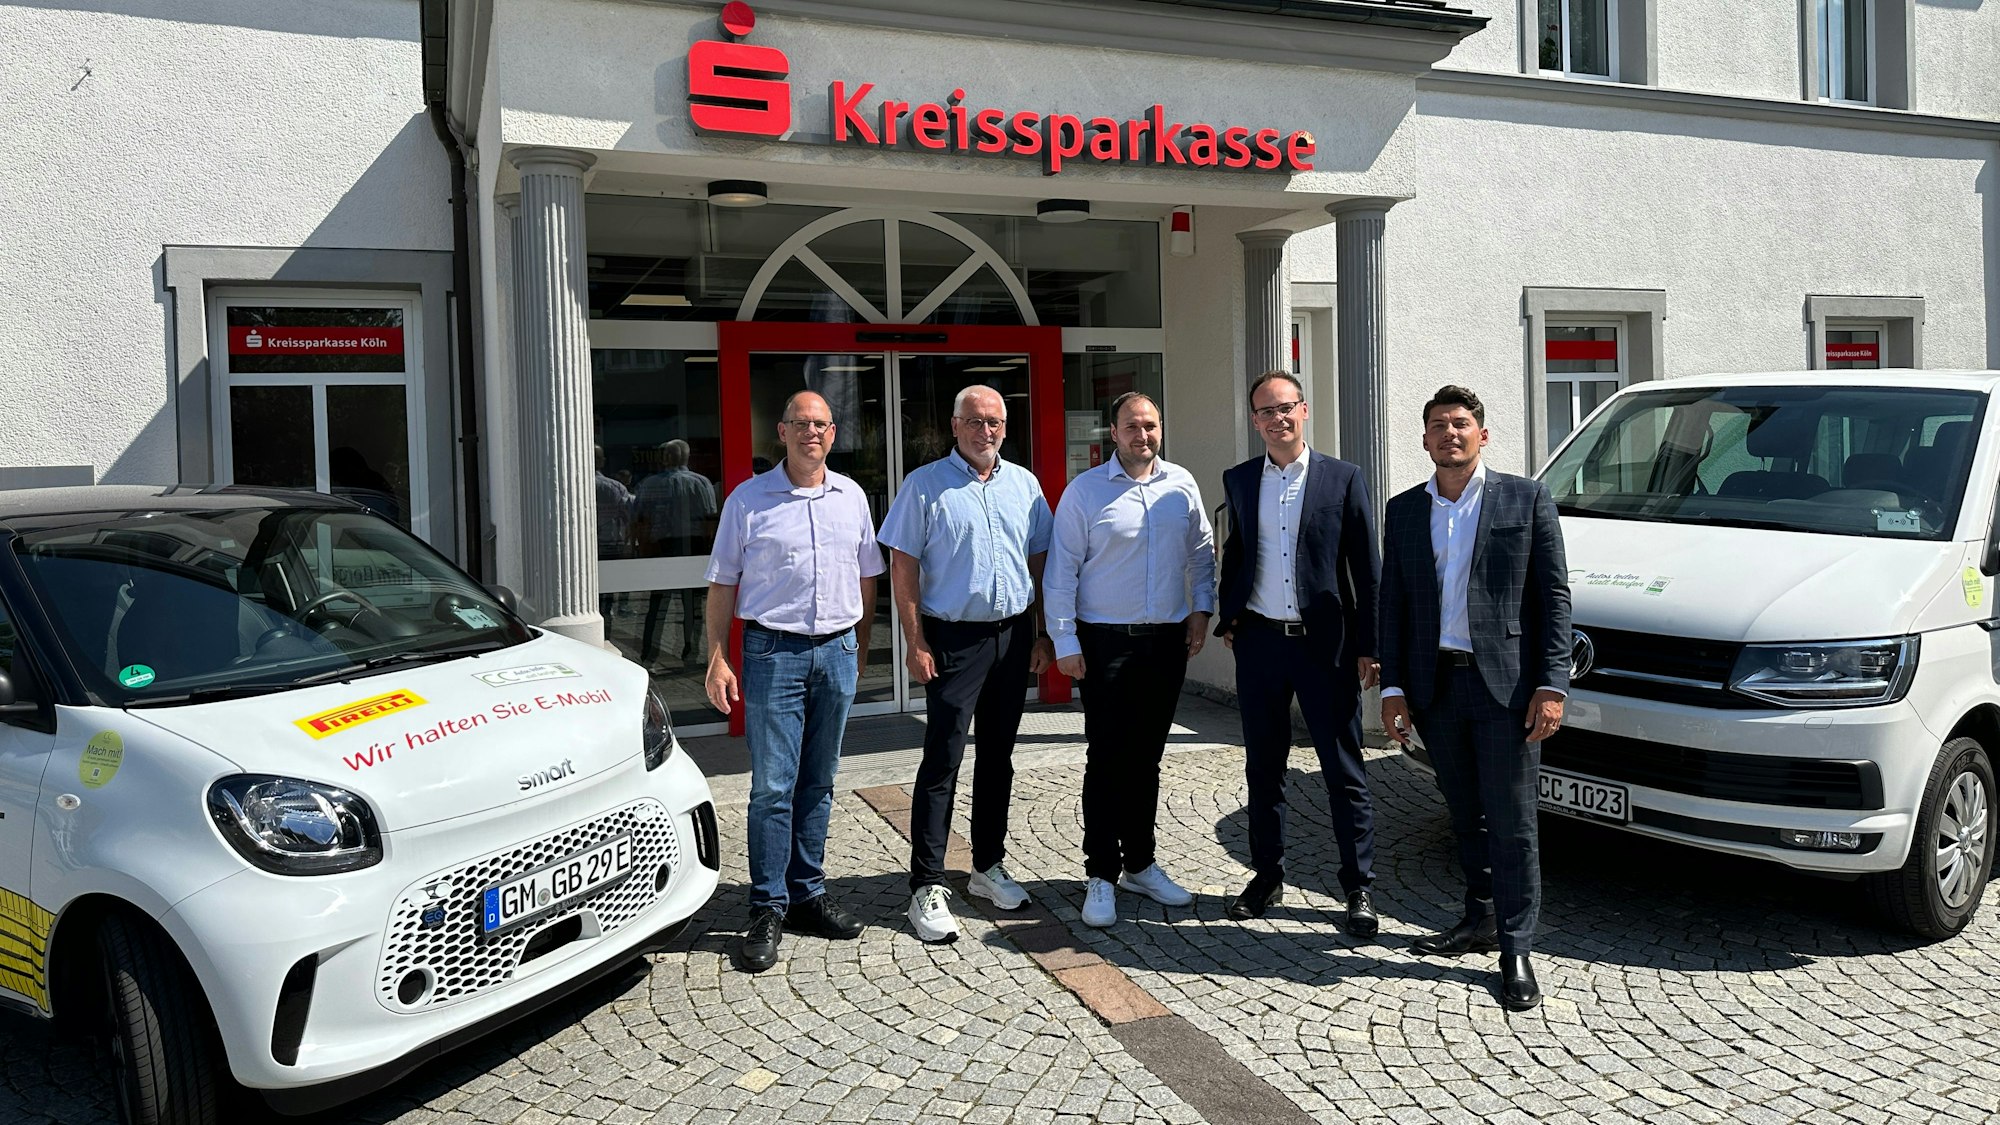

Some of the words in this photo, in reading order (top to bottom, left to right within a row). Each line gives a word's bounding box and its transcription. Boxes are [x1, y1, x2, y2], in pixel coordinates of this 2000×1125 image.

[828, 80, 1317, 176] Kreissparkasse
[267, 337, 358, 350] Kreissparkasse
[360, 337, 388, 348] Köln
[1826, 349, 1860, 358] reissparkasse
[1860, 349, 1872, 357] Köln
[130, 666, 142, 676] 4
[308, 693, 415, 733] PIRELLI
[342, 742, 397, 771] Wir
[405, 713, 488, 750] halten
[492, 701, 532, 720] Sie
[534, 689, 613, 710] E-Mobil
[86, 744, 107, 757] Mach
[107, 748, 123, 759] mit!
[517, 757, 576, 792] smart
[1539, 774, 1563, 801] CC
[1568, 782, 1622, 815] 1023
[502, 878, 536, 919] GM
[552, 861, 583, 899] GB
[488, 912, 496, 923] D
